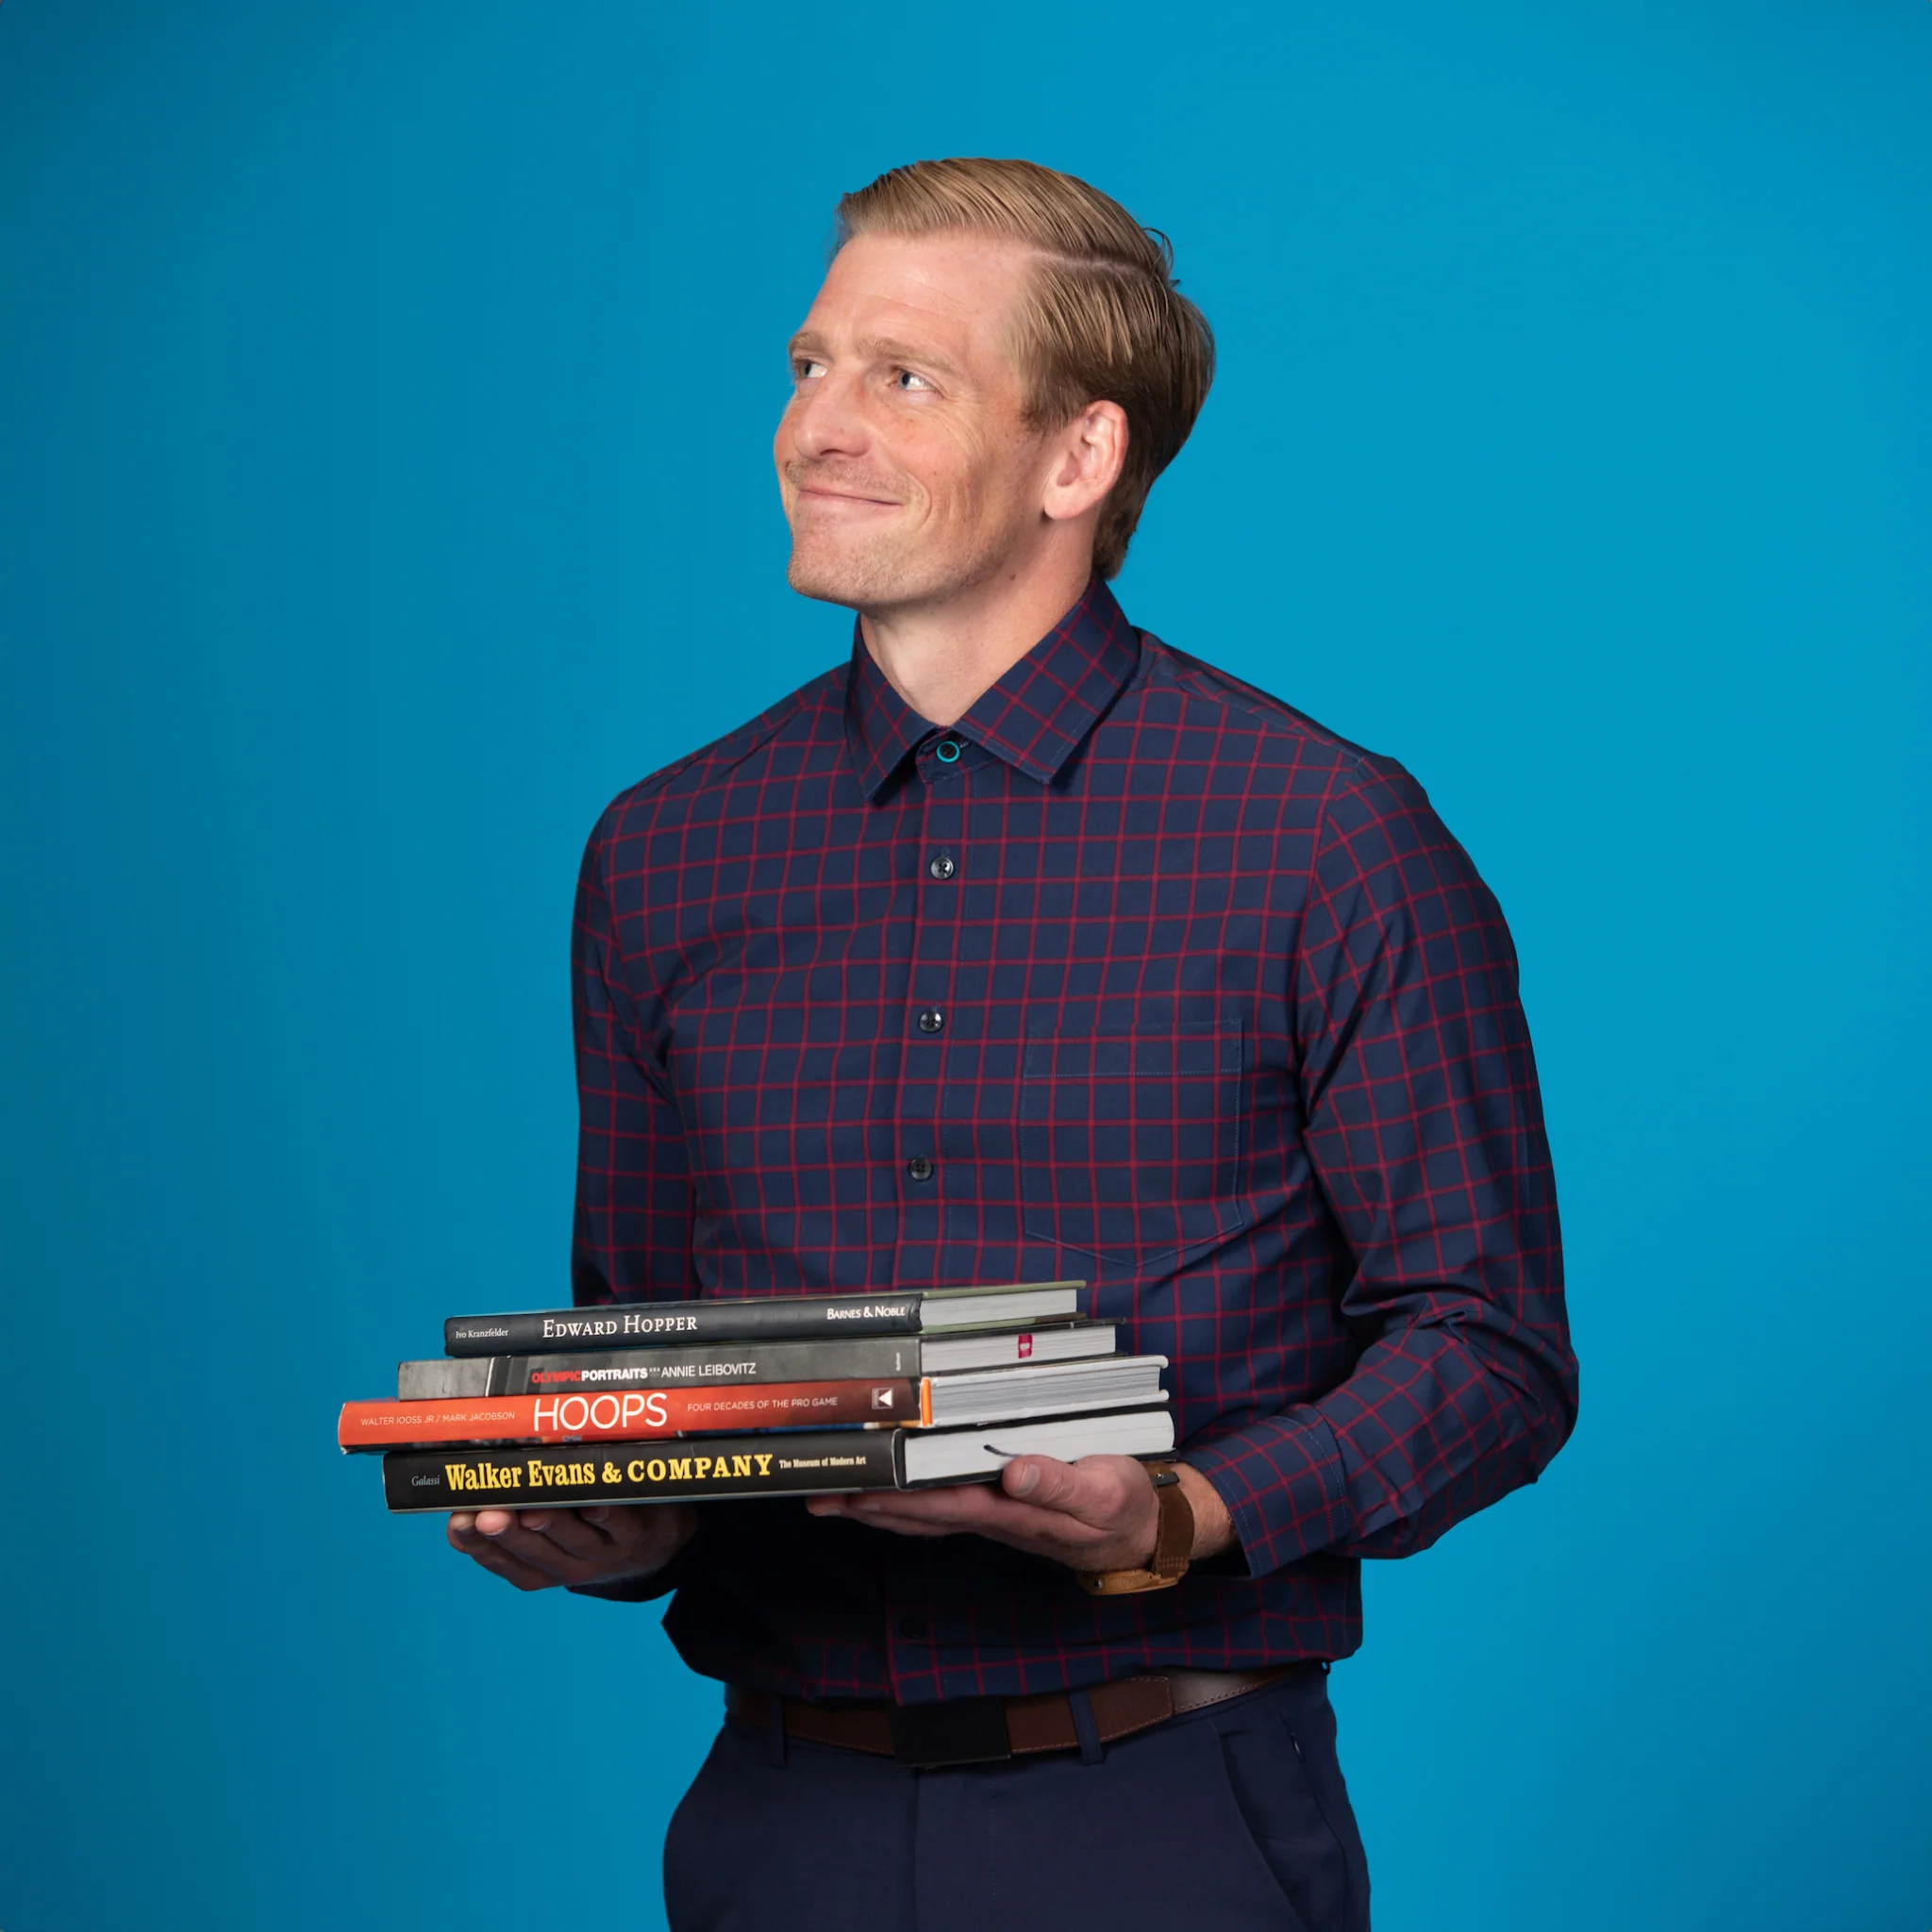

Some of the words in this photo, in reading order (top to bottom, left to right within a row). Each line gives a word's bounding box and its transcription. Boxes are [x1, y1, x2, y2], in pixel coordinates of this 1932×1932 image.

[826, 1308, 862, 1320] BARNES
[863, 1306, 874, 1318] &
[874, 1306, 906, 1317] NOBLE
[456, 1330, 467, 1339] Ivo
[468, 1327, 509, 1339] Kranzfelder
[542, 1318, 618, 1339] EDWARD
[623, 1314, 698, 1334] HOPPER
[660, 1365, 696, 1378] ANNIE
[698, 1362, 757, 1377] LEIBOVITZ
[533, 1391, 669, 1432] HOOPS
[687, 1403, 712, 1412] FOUR
[713, 1401, 756, 1411] DECADES
[757, 1400, 770, 1409] OF
[772, 1399, 790, 1408] THE
[791, 1398, 810, 1407] PRO
[811, 1397, 839, 1407] GAME
[360, 1417, 394, 1426] WALTER
[396, 1416, 423, 1424] IOOSS
[424, 1415, 435, 1424] JR
[442, 1414, 467, 1423] MARK
[470, 1411, 516, 1422] JACOBSON
[778, 1458, 791, 1469] The
[792, 1457, 821, 1469] Museum
[821, 1457, 828, 1467] of
[829, 1456, 855, 1467] Modern
[855, 1455, 867, 1465] Art
[444, 1462, 523, 1491] Walker
[527, 1459, 596, 1487] Evans
[601, 1461, 623, 1484] &
[626, 1454, 773, 1482] COMPANY
[411, 1474, 441, 1487] Galassi
